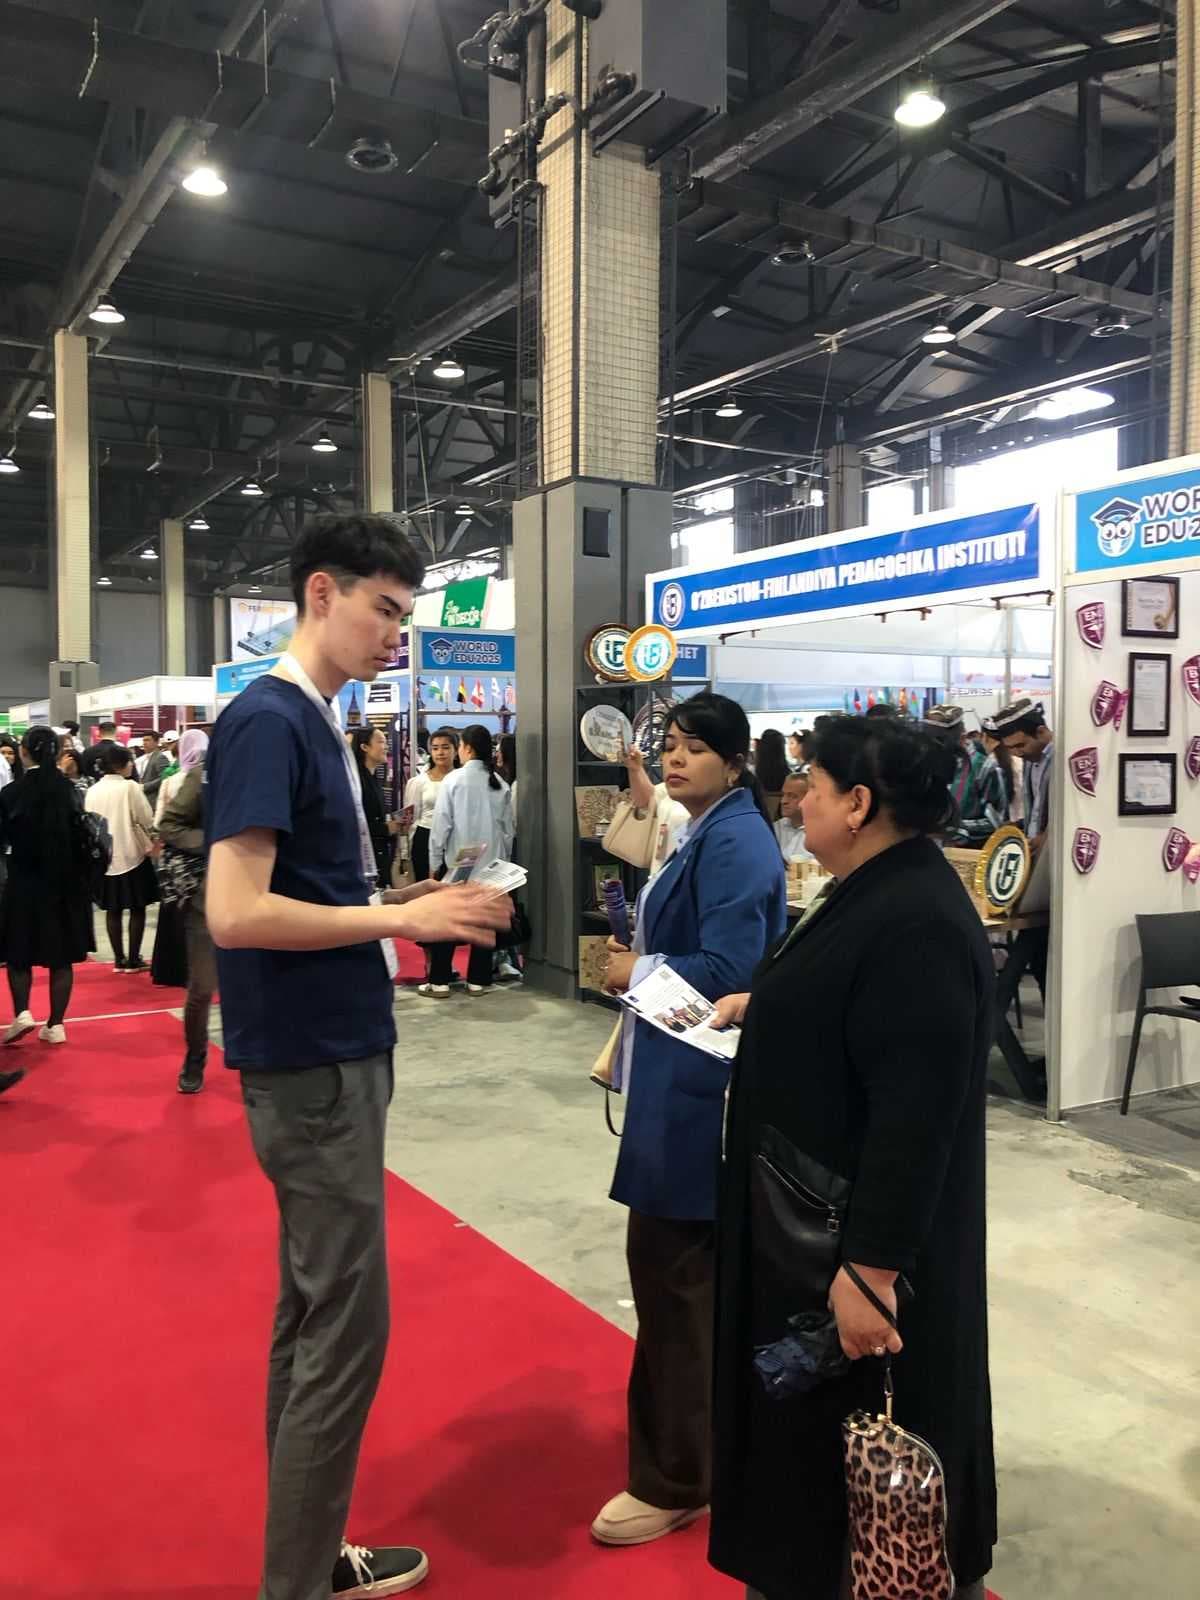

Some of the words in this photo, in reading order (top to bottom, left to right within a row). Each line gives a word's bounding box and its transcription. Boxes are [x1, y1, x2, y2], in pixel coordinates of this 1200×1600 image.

[1144, 520, 1186, 545] EDU
[838, 547, 935, 588] PEDAGOGIKA
[937, 530, 1026, 571] INSTITUTI
[456, 641, 497, 652] WORLD
[454, 653, 473, 662] EDU
